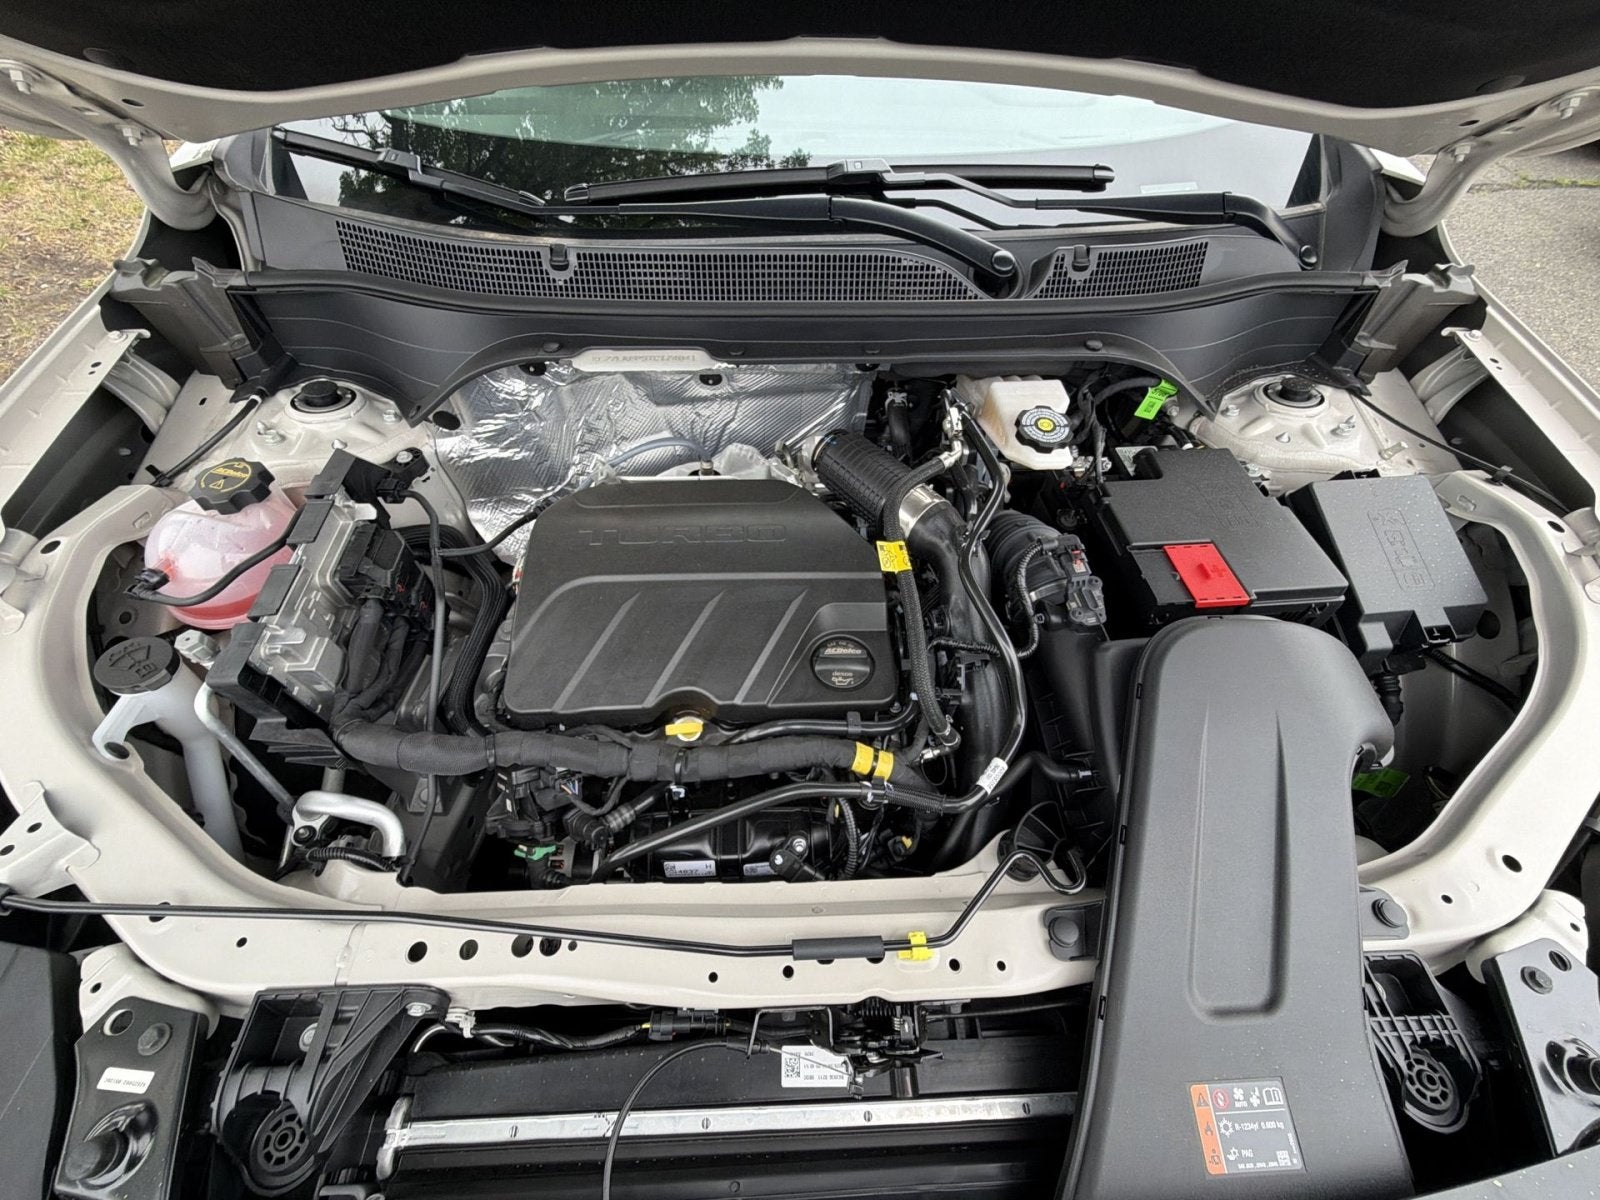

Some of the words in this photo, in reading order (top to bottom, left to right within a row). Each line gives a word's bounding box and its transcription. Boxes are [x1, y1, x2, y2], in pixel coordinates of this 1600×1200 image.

[578, 525, 787, 546] TURBO
[1276, 1119, 1285, 1129] kg
[1241, 1149, 1254, 1158] PAG
